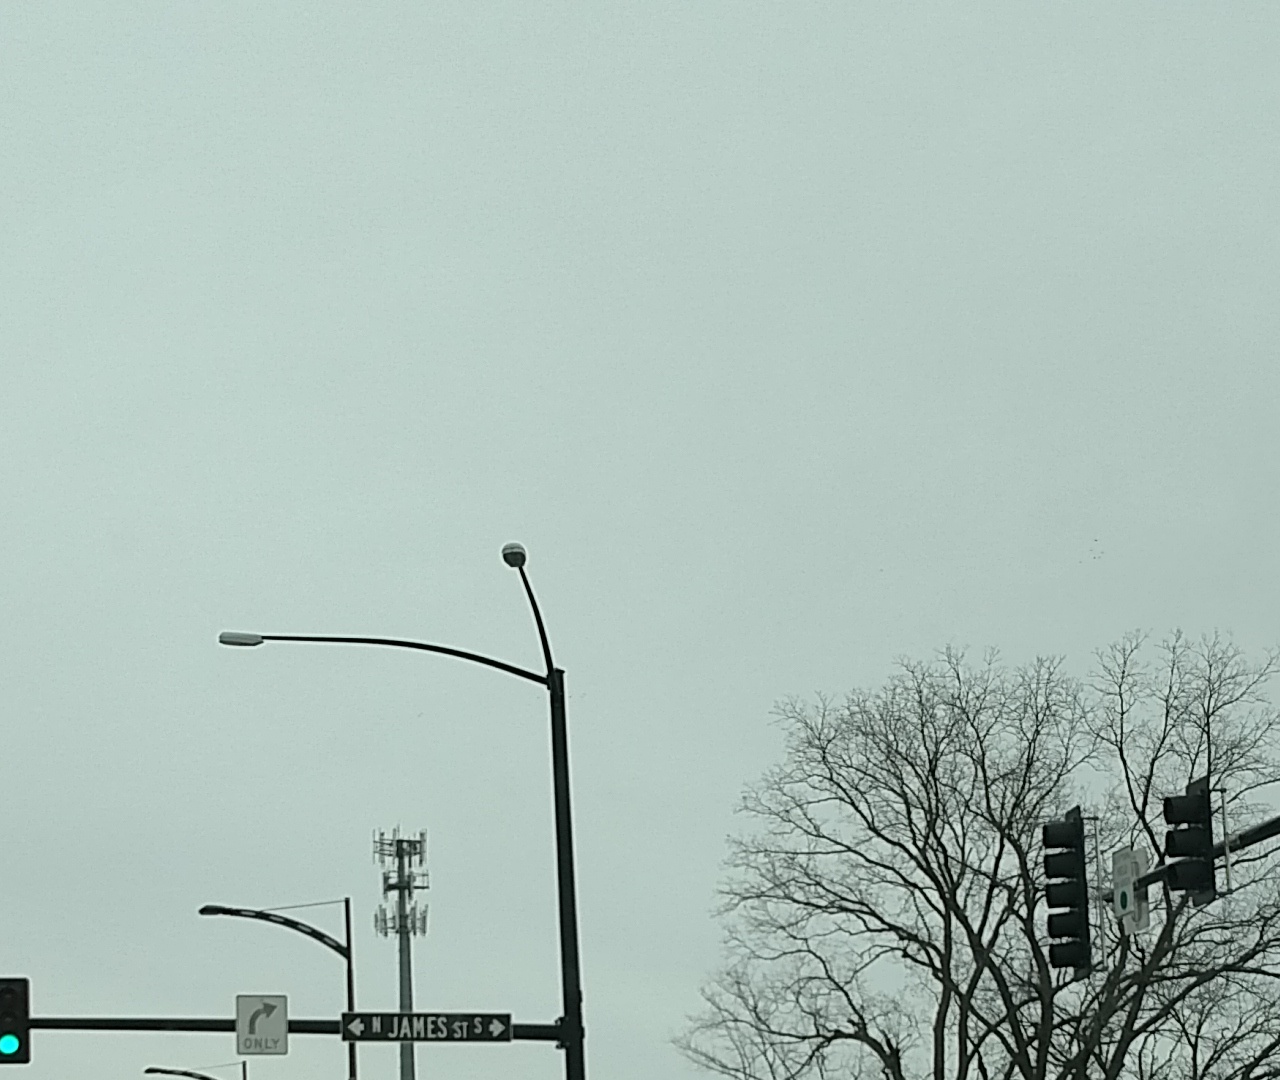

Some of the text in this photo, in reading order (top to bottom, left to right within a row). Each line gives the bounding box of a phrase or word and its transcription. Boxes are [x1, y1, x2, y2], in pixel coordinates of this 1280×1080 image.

[372, 1016, 483, 1039] N JAMES ST S
[244, 1037, 280, 1050] ONLY
